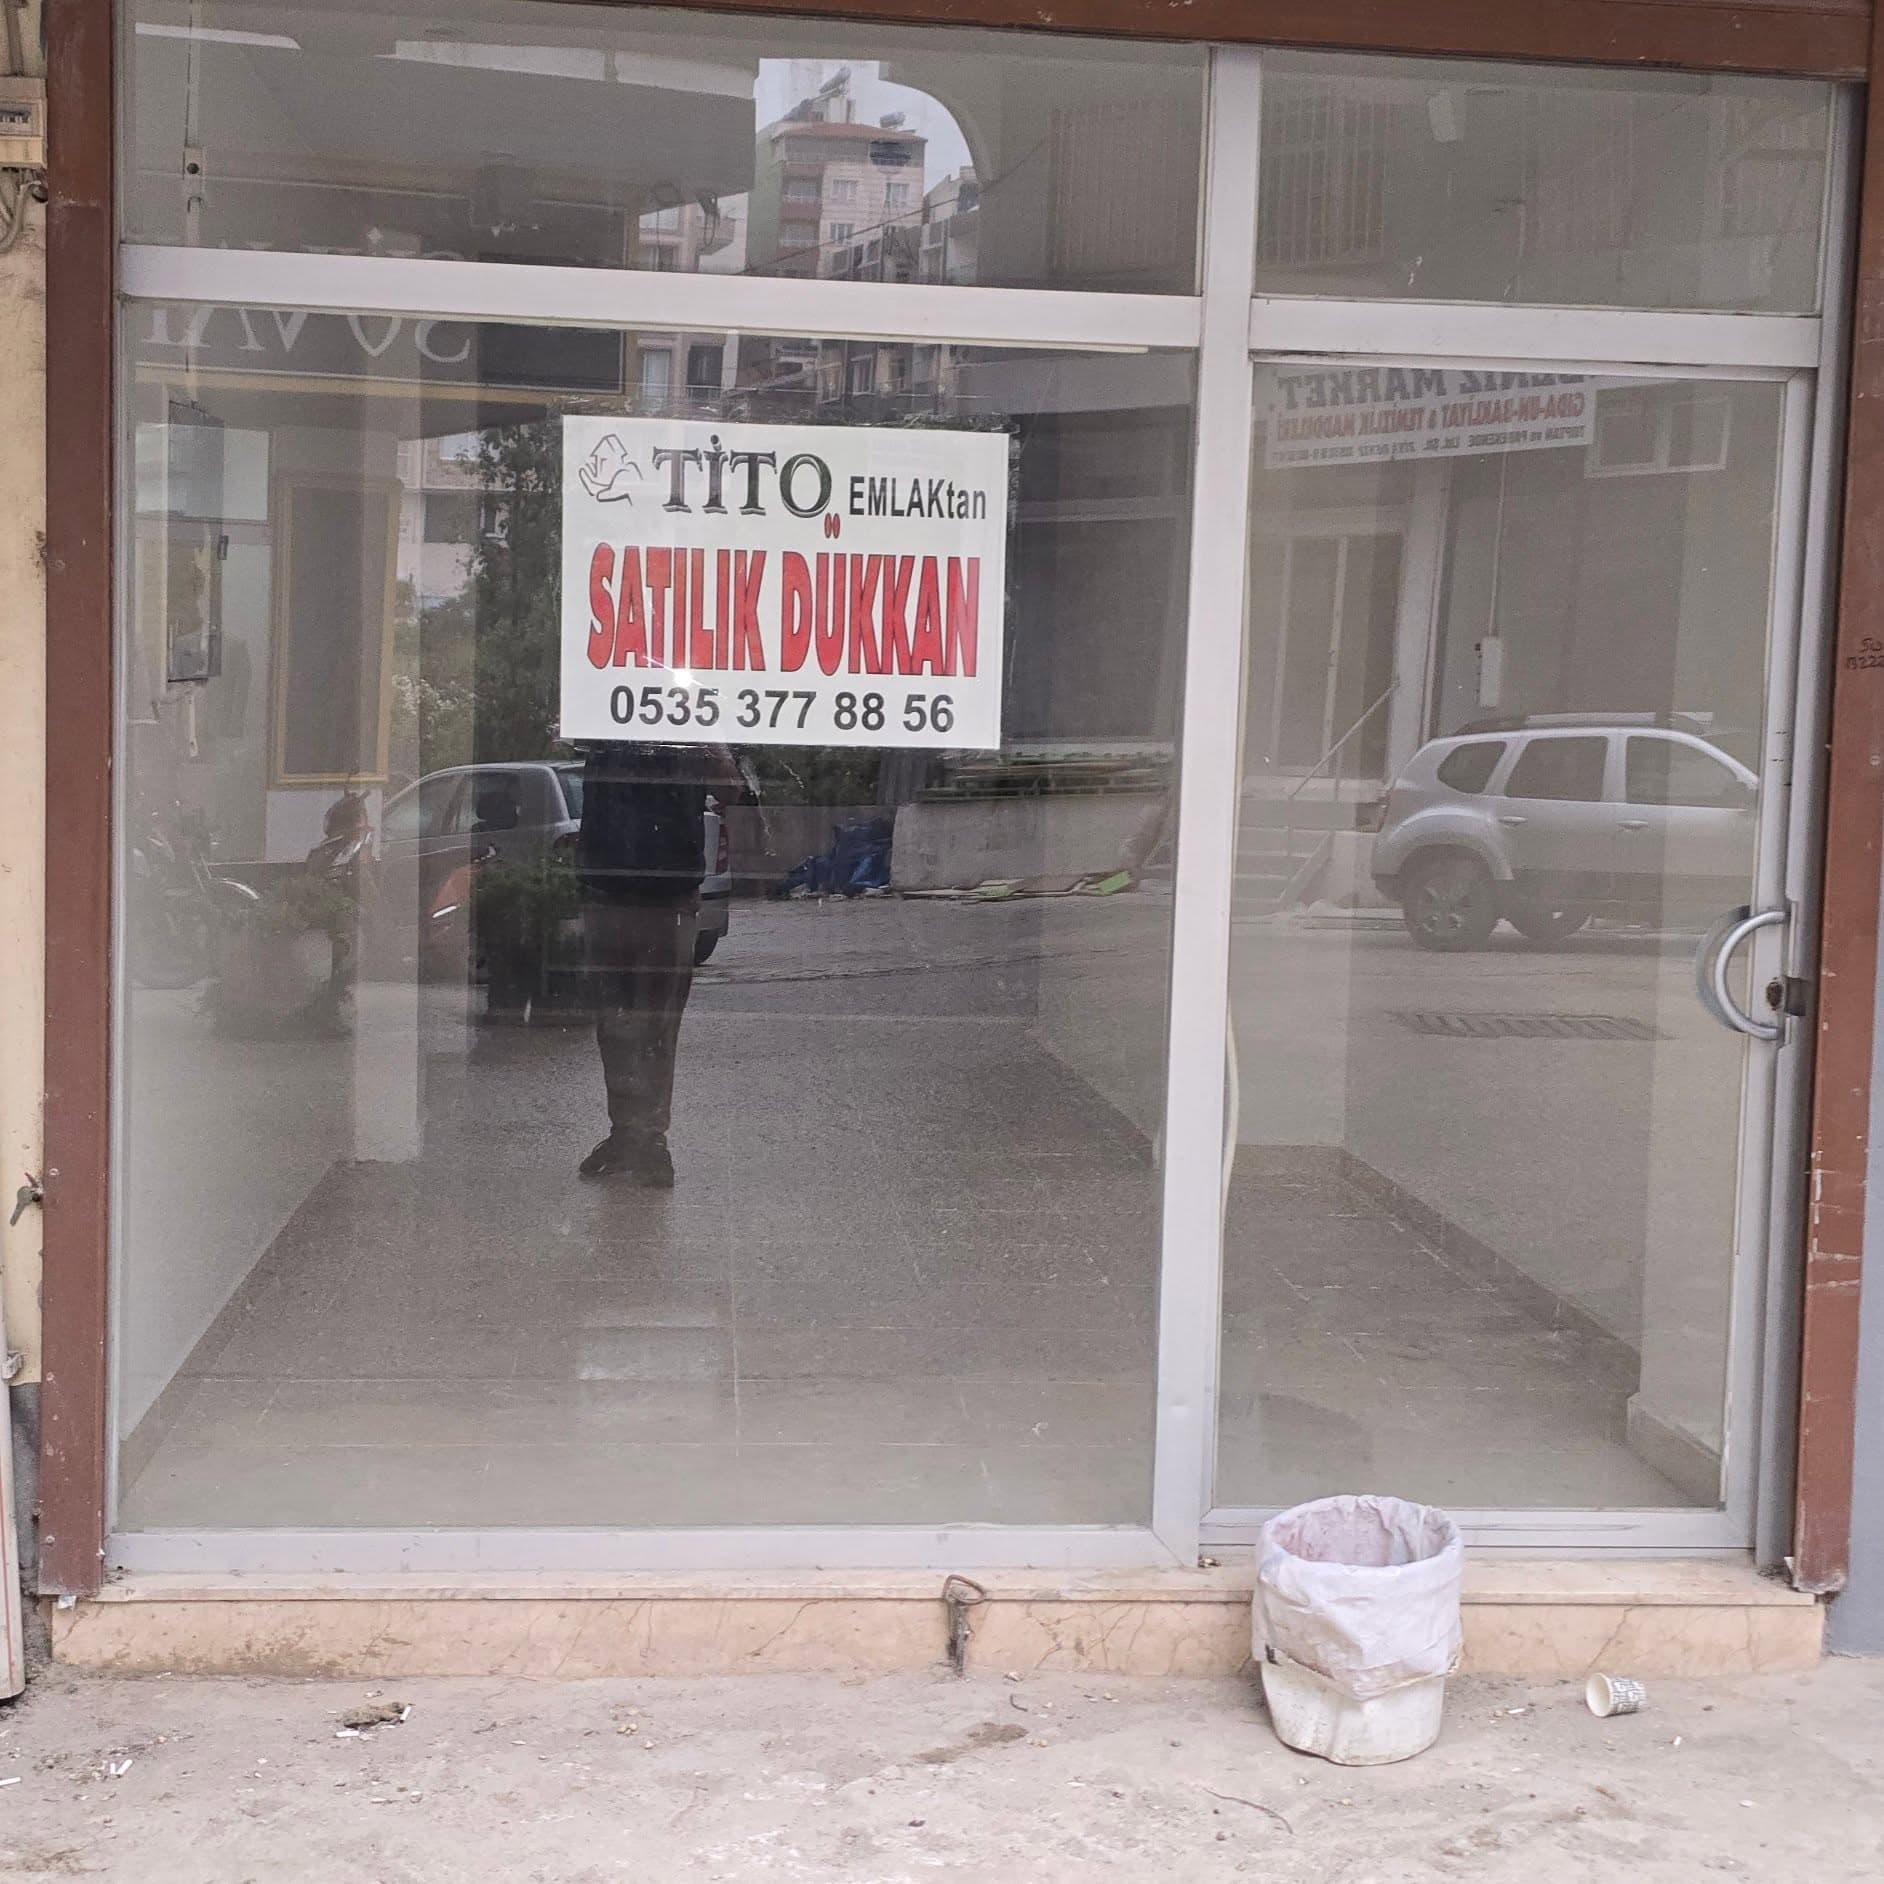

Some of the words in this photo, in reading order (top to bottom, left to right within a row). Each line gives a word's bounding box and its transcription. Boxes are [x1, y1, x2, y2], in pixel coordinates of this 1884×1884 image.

[652, 435, 832, 518] TİTO
[849, 475, 987, 520] EMLAKtan
[587, 542, 767, 671] SATILIK
[780, 513, 981, 677] DÜKKAN
[610, 685, 720, 727] 0535
[736, 690, 817, 729] 377
[833, 692, 885, 732] 88
[903, 694, 955, 733] 56
